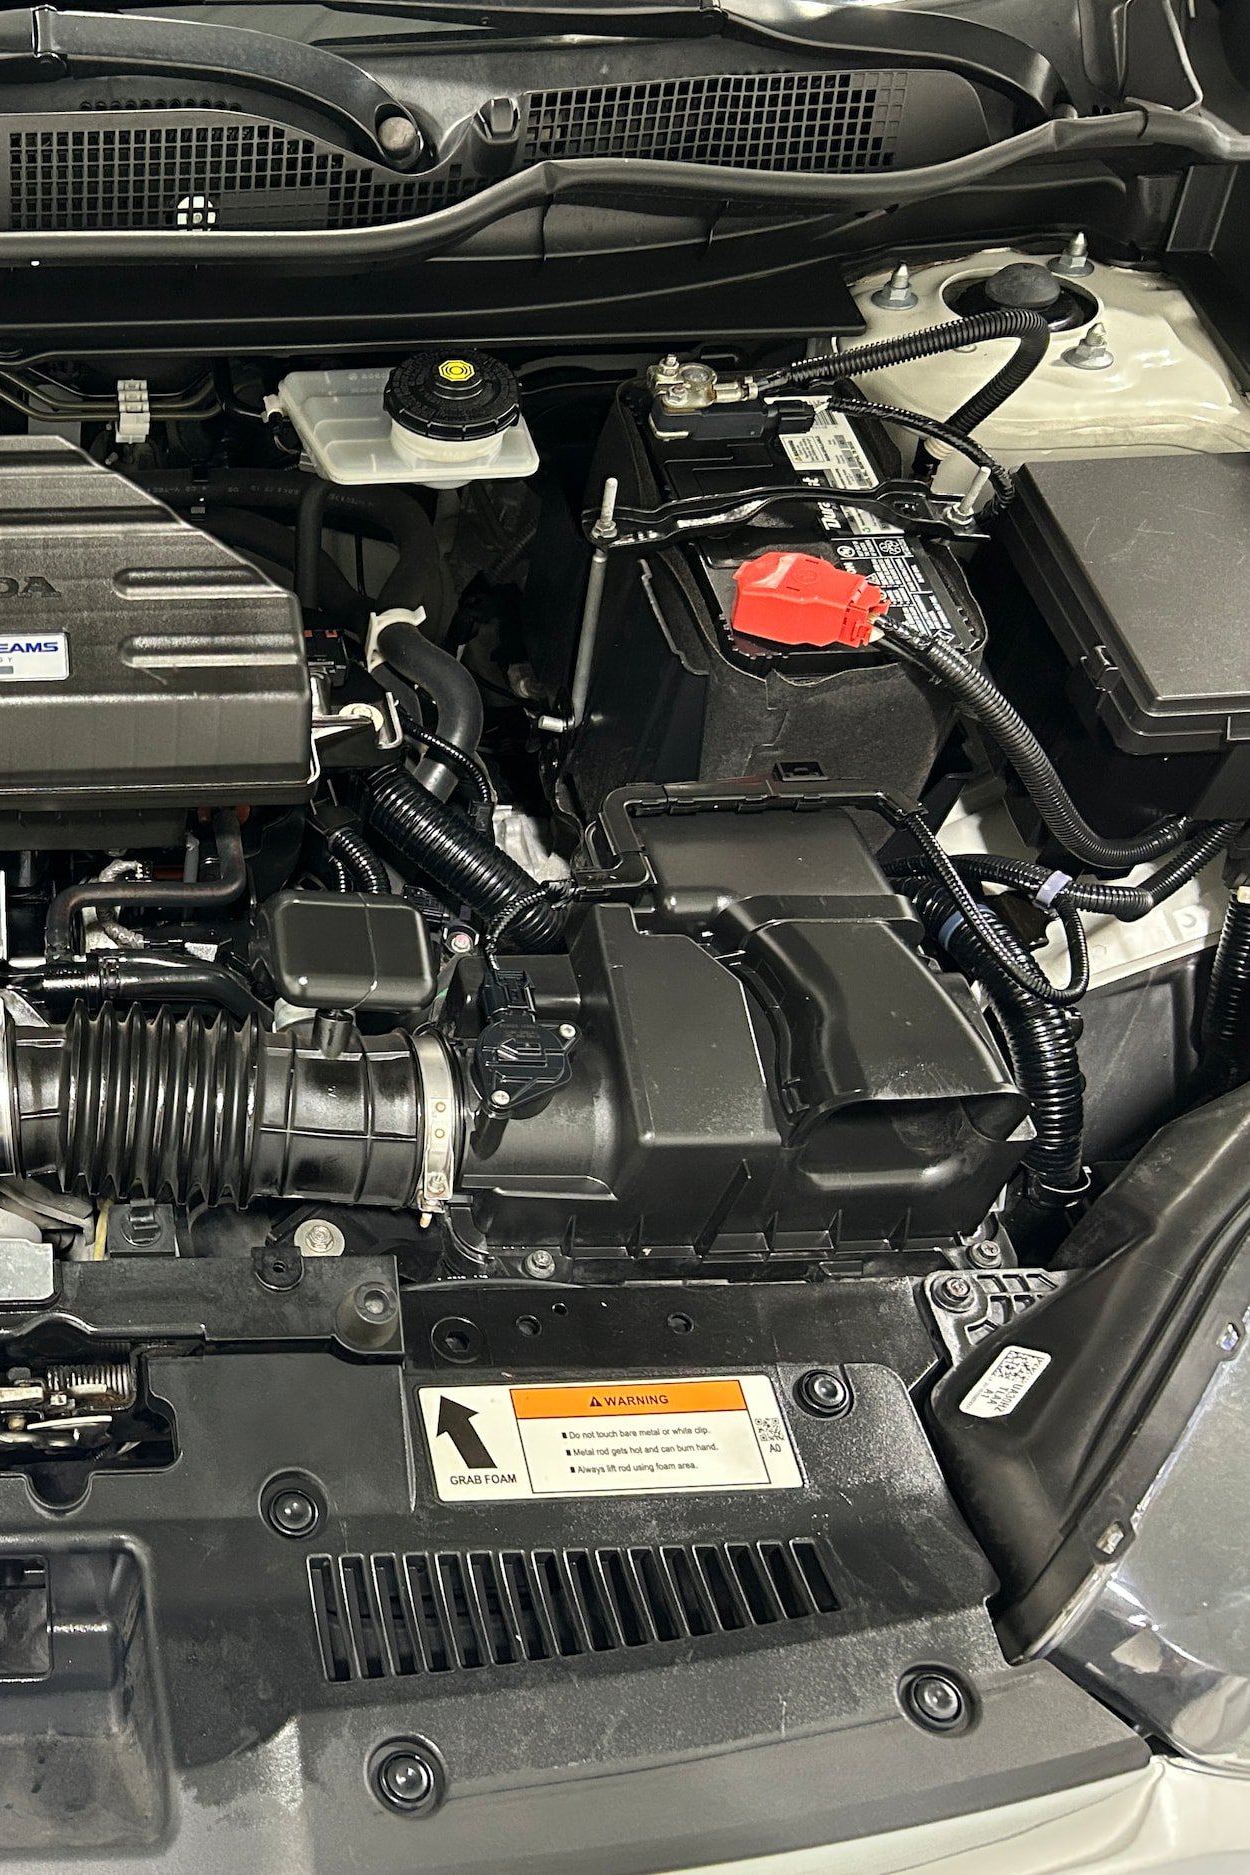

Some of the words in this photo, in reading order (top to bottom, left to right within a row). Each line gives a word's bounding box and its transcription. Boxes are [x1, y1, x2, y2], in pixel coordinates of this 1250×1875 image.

[604, 1394, 669, 1407] WARNING
[986, 1386, 1010, 1405] TLAA
[569, 1431, 580, 1440] Do
[582, 1431, 595, 1439] not
[596, 1429, 618, 1439] touch
[619, 1428, 637, 1438] bare
[639, 1427, 661, 1437] metal
[662, 1428, 670, 1436] or
[672, 1426, 692, 1436] white
[694, 1426, 711, 1437] clip.
[573, 1447, 595, 1457] Metal
[596, 1447, 610, 1456] rod
[611, 1447, 628, 1458] gets
[629, 1445, 643, 1455] hot
[644, 1445, 659, 1455] and
[660, 1445, 673, 1453] can
[674, 1444, 695, 1454] burn
[696, 1442, 719, 1453] hand.
[577, 1464, 606, 1476] Always
[607, 1464, 617, 1473] lift
[618, 1463, 632, 1473] rod
[633, 1463, 654, 1474] using
[656, 1462, 676, 1472] foam
[678, 1461, 698, 1471] area.
[450, 1475, 482, 1486] GRAB
[485, 1474, 517, 1485] FOAM
